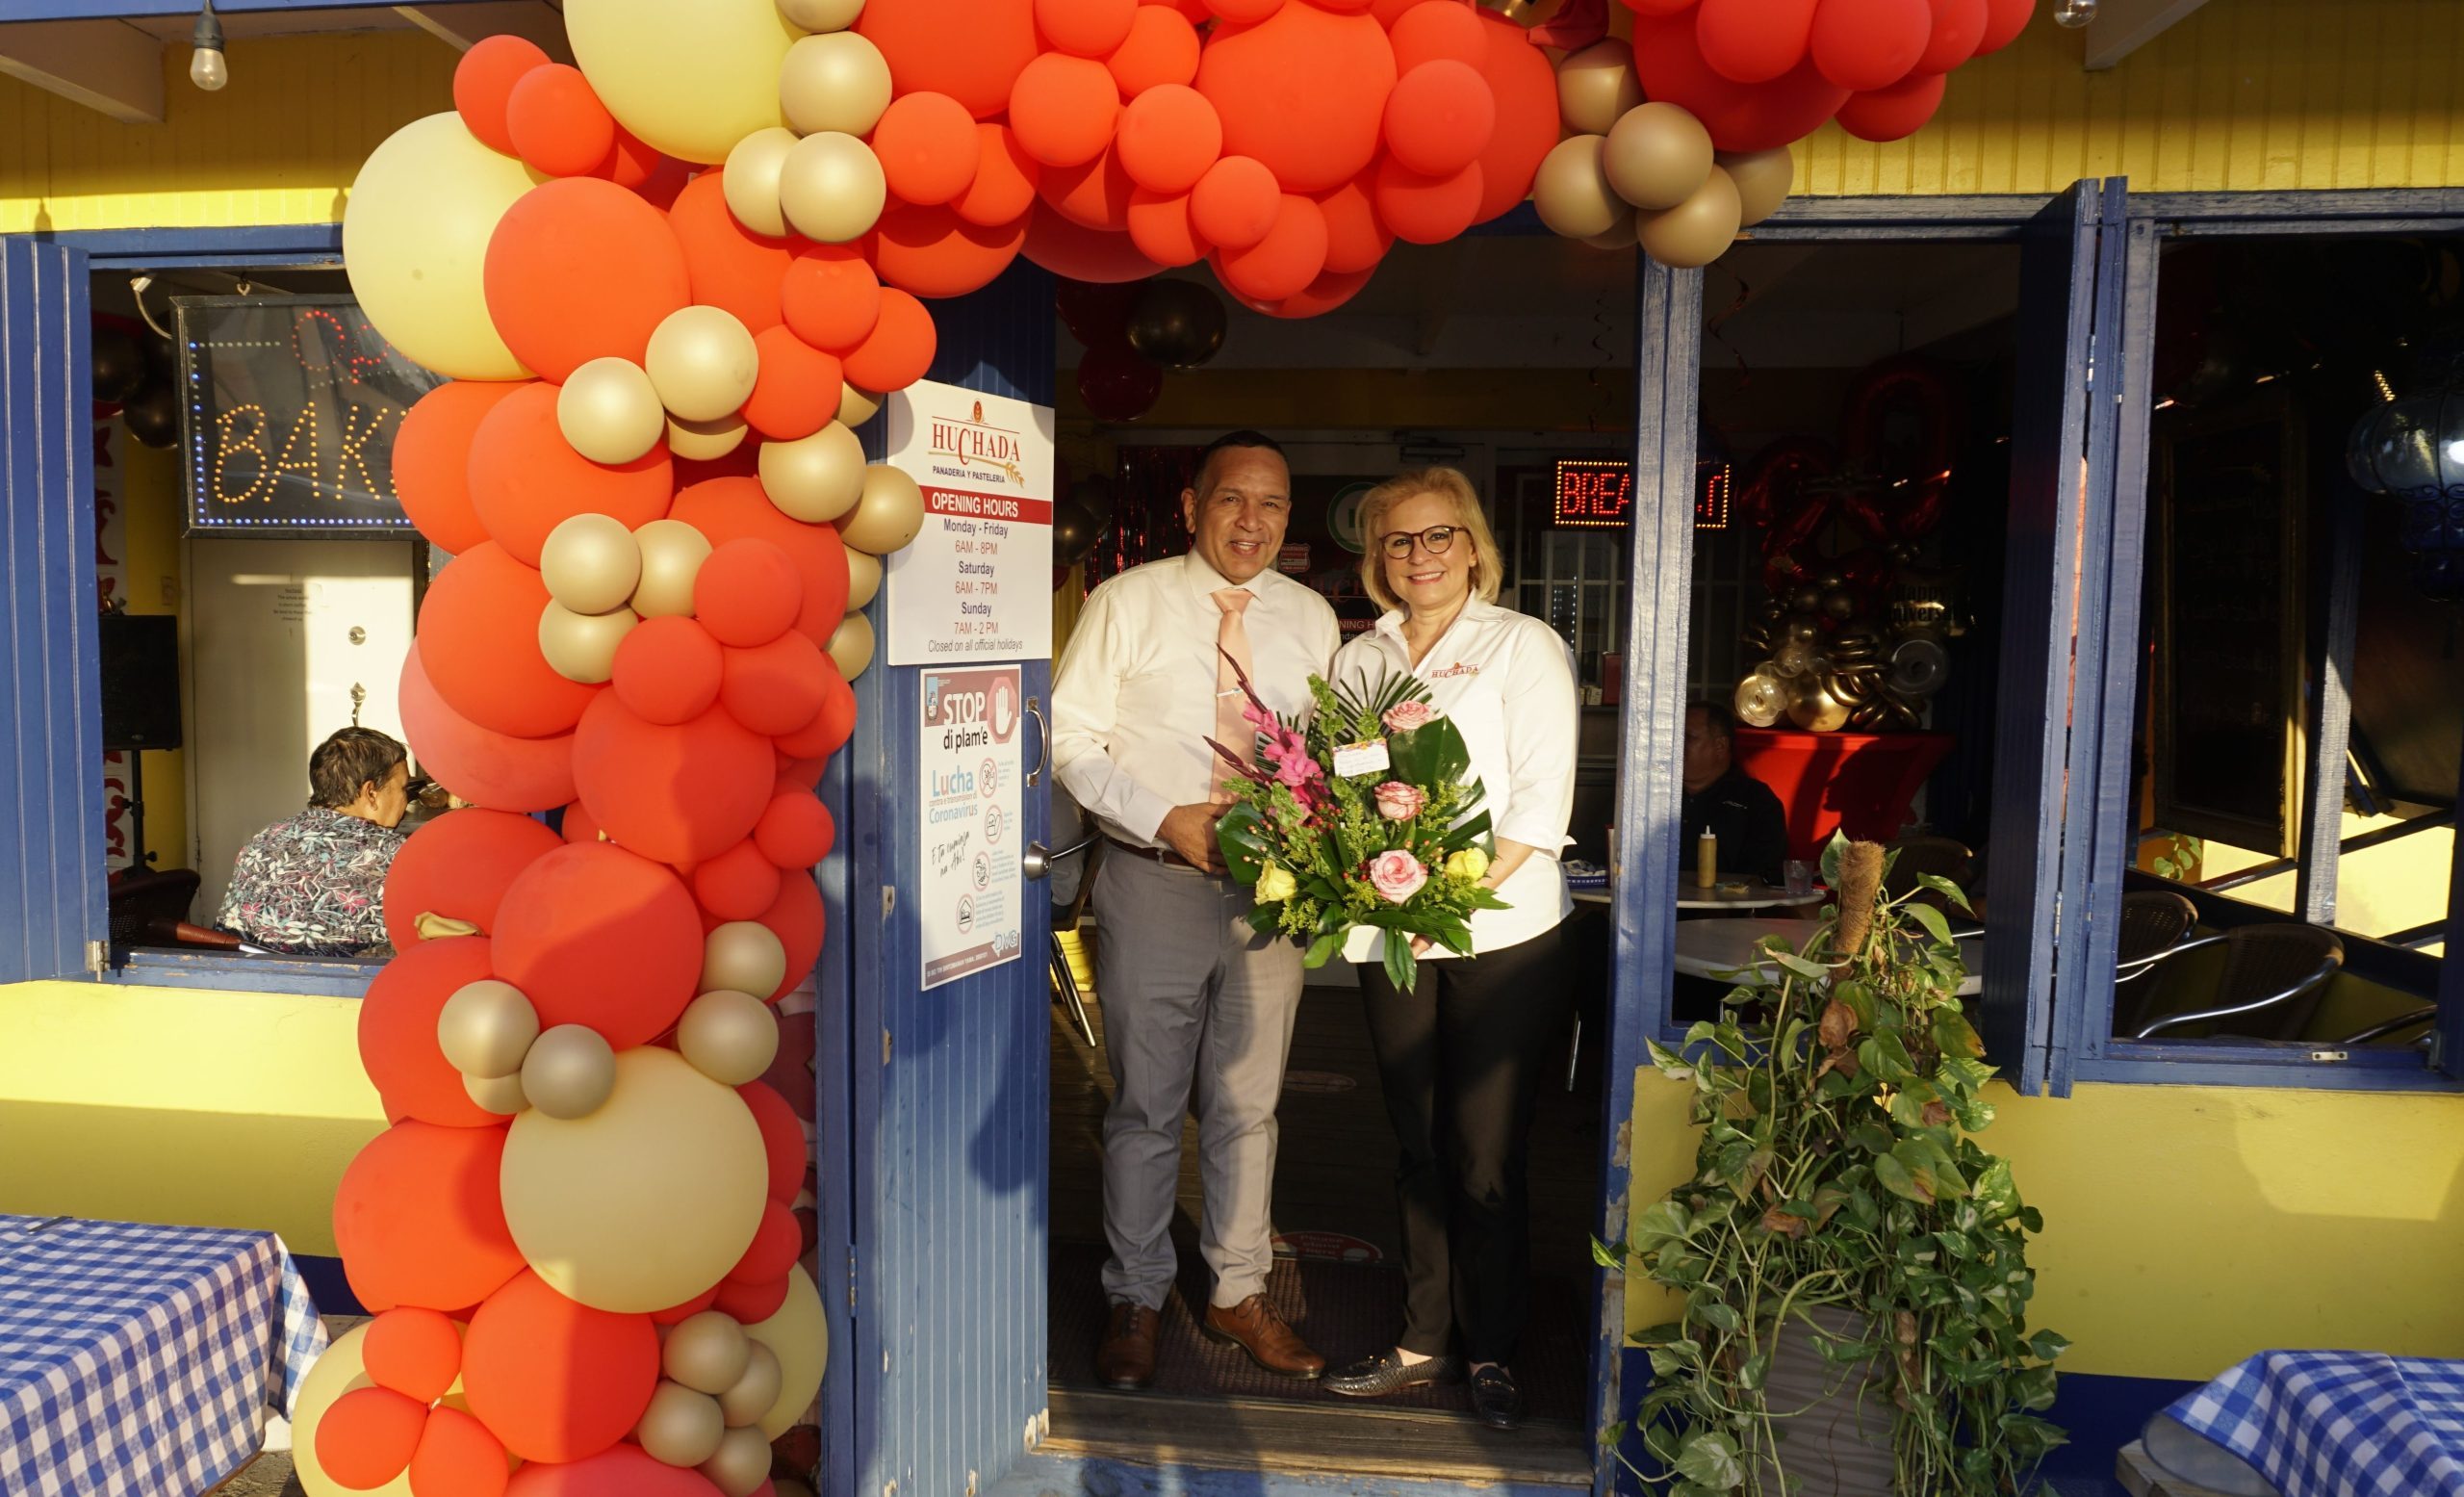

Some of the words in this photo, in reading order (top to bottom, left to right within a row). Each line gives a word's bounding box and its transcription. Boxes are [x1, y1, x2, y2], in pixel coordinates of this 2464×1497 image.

[214, 399, 412, 503] BAK
[932, 423, 1020, 466] HUCHADA
[933, 465, 965, 479] PANADERIA
[966, 471, 972, 479] Y
[972, 471, 1006, 483] PASTELERIA
[932, 491, 981, 515] OPENING
[983, 497, 1019, 518] HOURS
[943, 518, 977, 536] Monday
[984, 522, 1009, 538] Friday
[955, 539, 973, 555] 6AM
[980, 541, 998, 555] 8PM
[959, 560, 994, 579] Saturday
[955, 581, 973, 594] 6AM
[980, 581, 998, 595] 7PM
[961, 602, 991, 618] Sunday
[954, 622, 972, 635] 7AM
[979, 622, 985, 634] 2
[986, 621, 998, 634] PM
[1339, 620, 1365, 629] NING
[928, 639, 953, 653] Closed
[955, 642, 963, 653] on
[975, 638, 996, 652] official
[997, 637, 1023, 653] holidays
[943, 691, 986, 725] STOP
[943, 728, 954, 750] di
[933, 764, 973, 797] Lucha
[930, 803, 978, 824] Coronavirus
